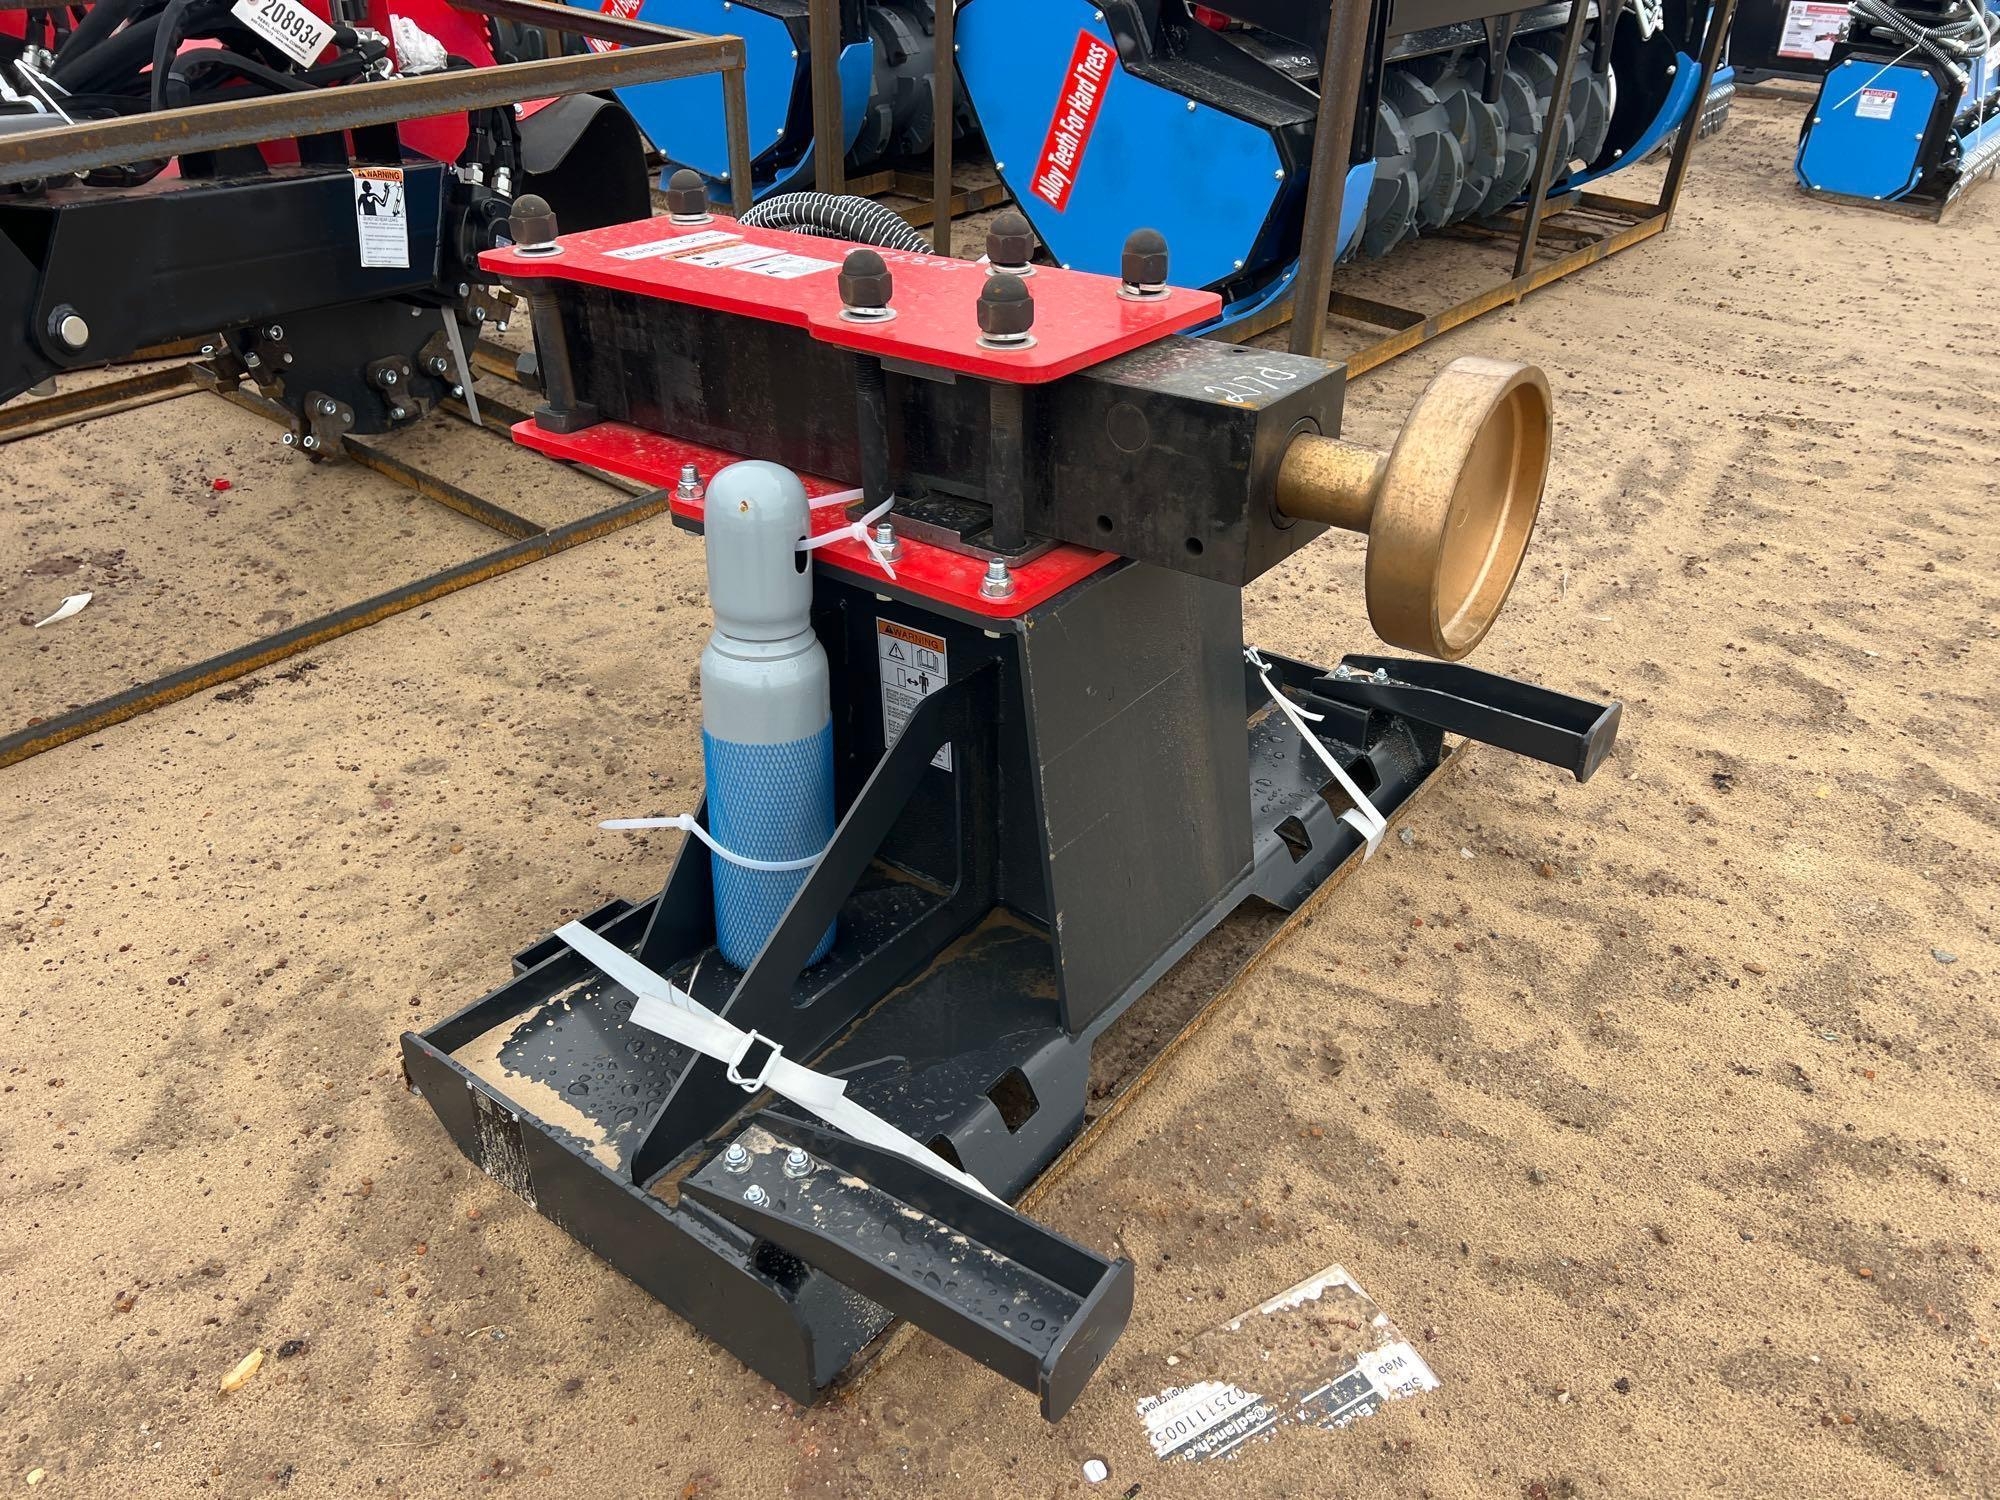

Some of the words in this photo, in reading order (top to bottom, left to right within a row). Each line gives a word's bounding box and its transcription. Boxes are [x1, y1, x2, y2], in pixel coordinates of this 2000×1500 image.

[260, 0, 322, 49] 208934
[1077, 42, 1108, 82] Tress
[1066, 72, 1098, 116] Hard
[1059, 110, 1086, 137] For
[1048, 130, 1079, 171] Teeth
[367, 169, 400, 180] WARNING
[1038, 165, 1071, 204] Alloy
[894, 628, 939, 649] WARNING
[1378, 1356, 1407, 1376] Web
